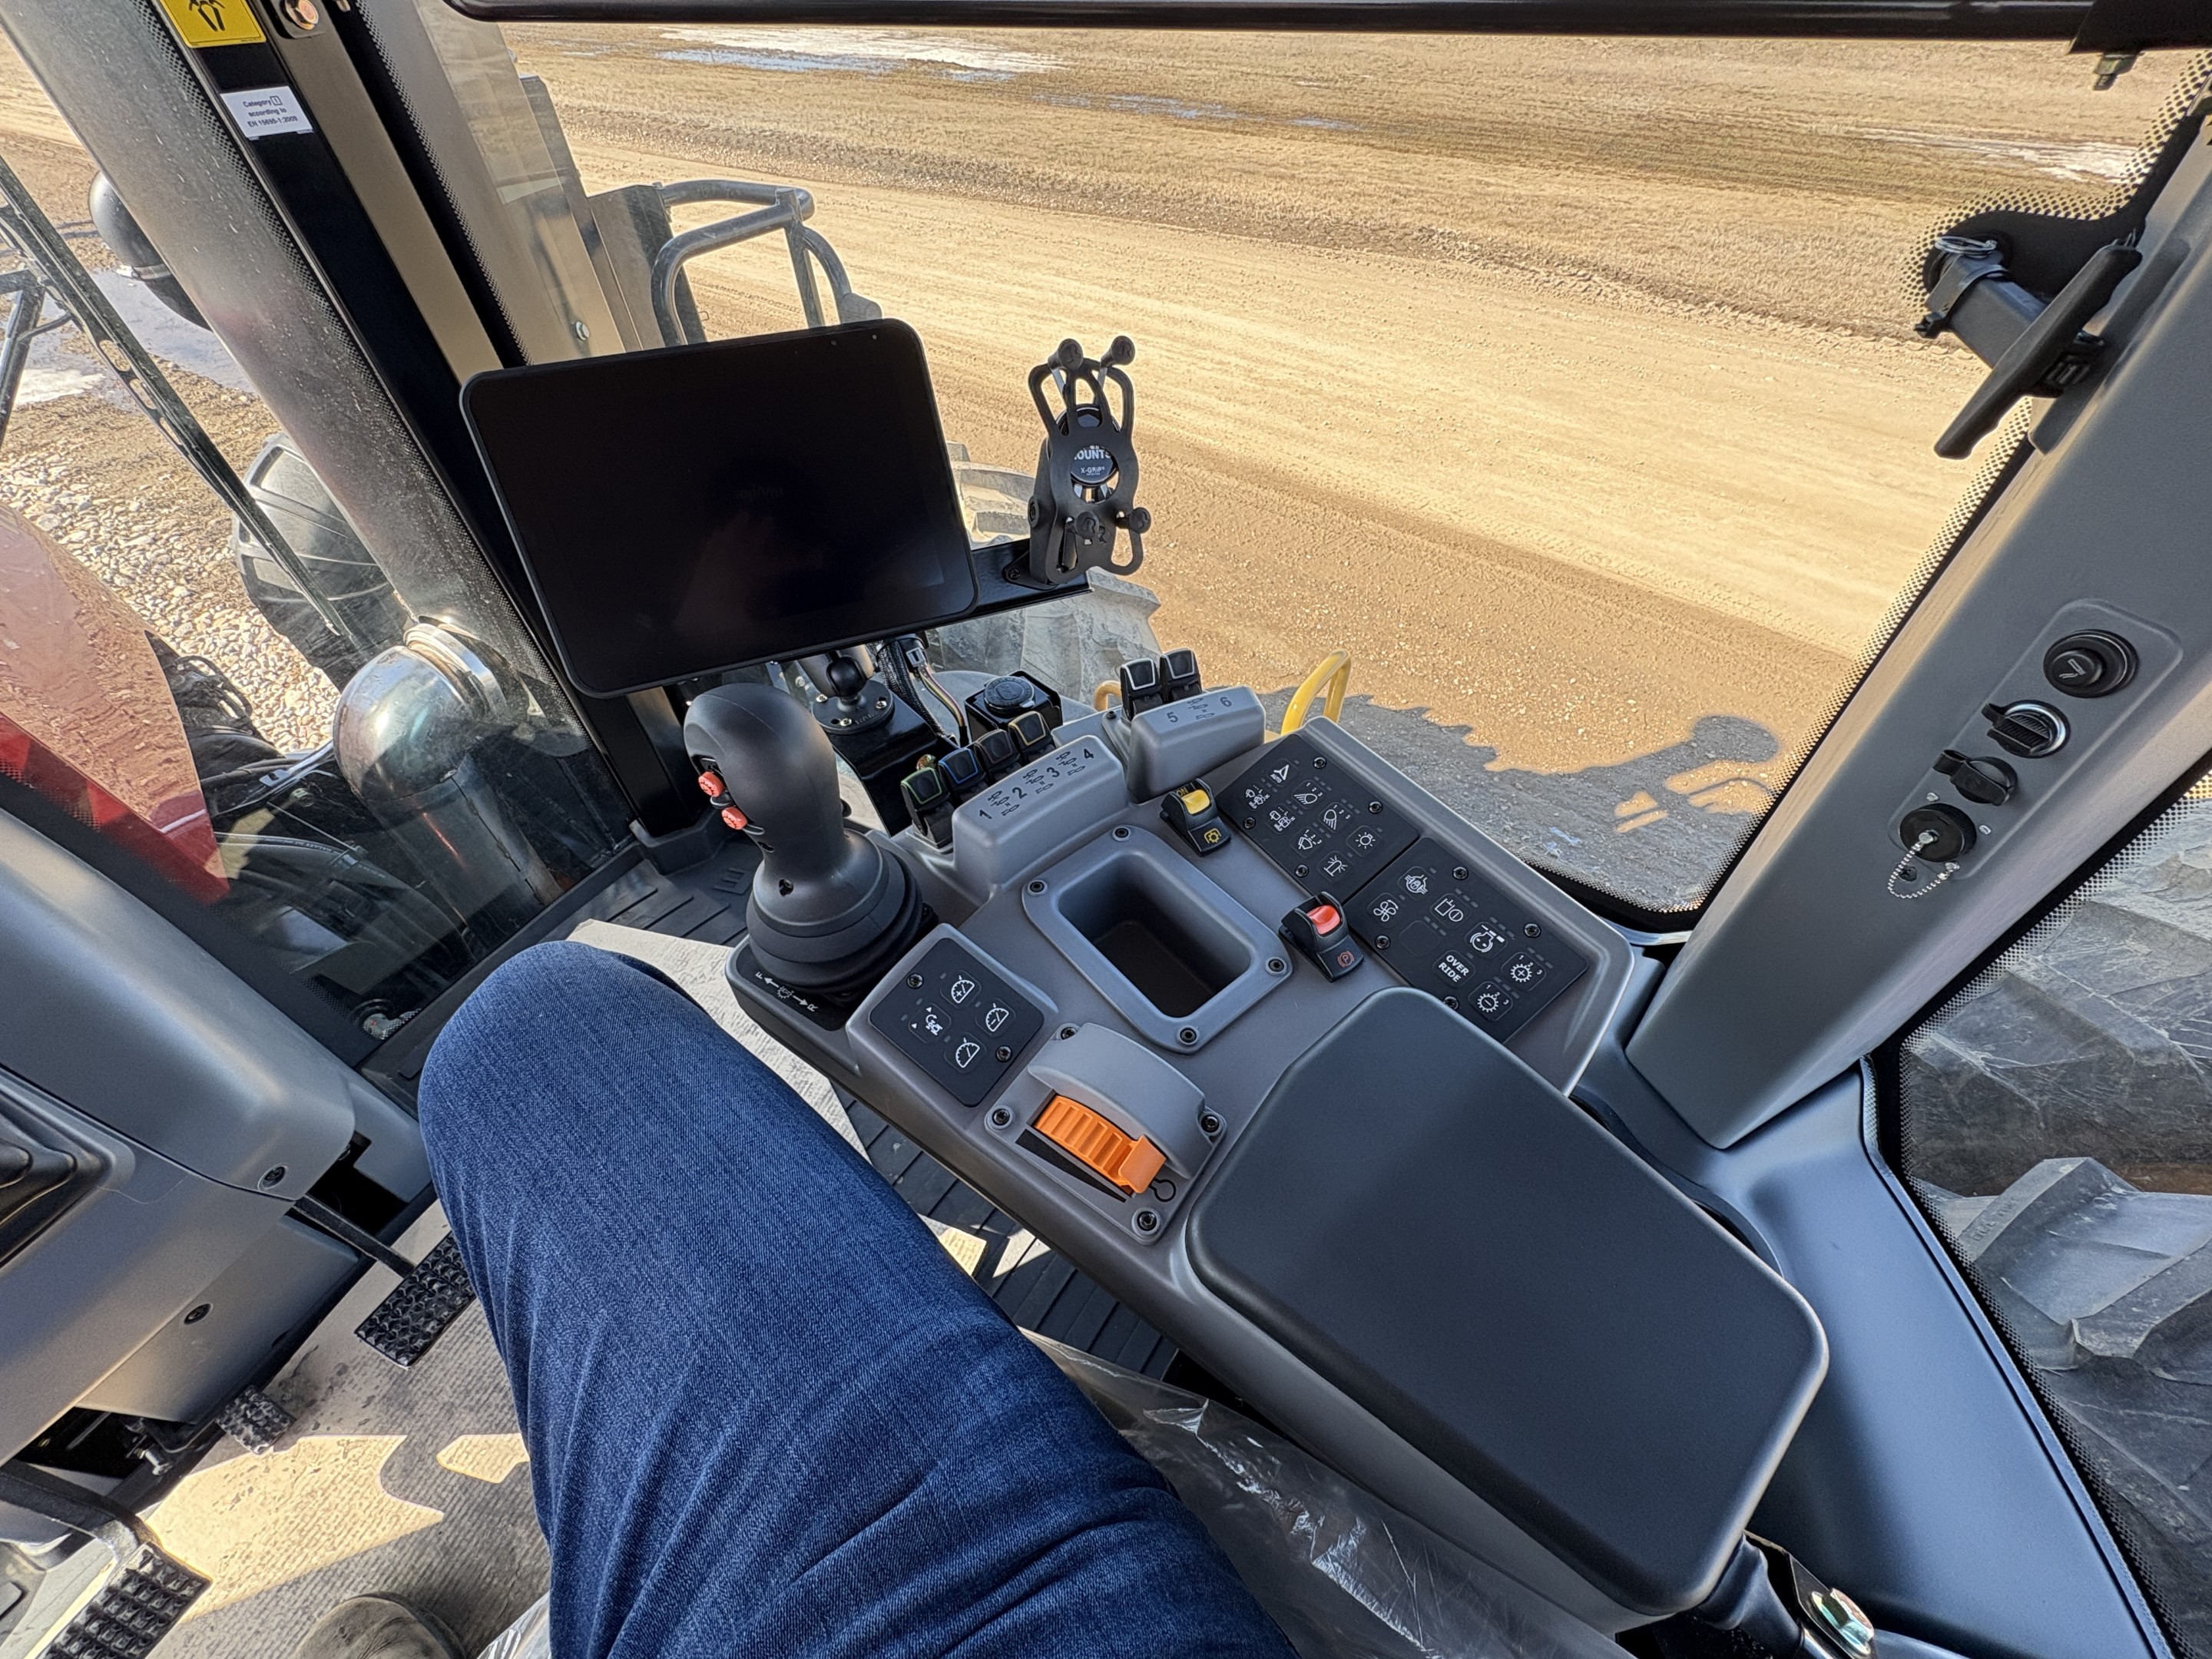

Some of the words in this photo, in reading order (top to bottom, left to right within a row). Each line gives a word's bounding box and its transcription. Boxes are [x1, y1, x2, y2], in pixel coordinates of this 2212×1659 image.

[248, 108, 280, 117] according
[1167, 711, 1178, 723] 5
[1220, 697, 1232, 707] 6
[979, 809, 992, 820] 1
[1012, 786, 1028, 800] 2
[1046, 767, 1061, 778] 3
[1083, 748, 1094, 760] 4
[1270, 773, 1282, 783] AUTO
[1176, 786, 1189, 796] ON
[1438, 962, 1462, 982] RIDE
[1445, 955, 1469, 976] OVER
[755, 971, 763, 979] F
